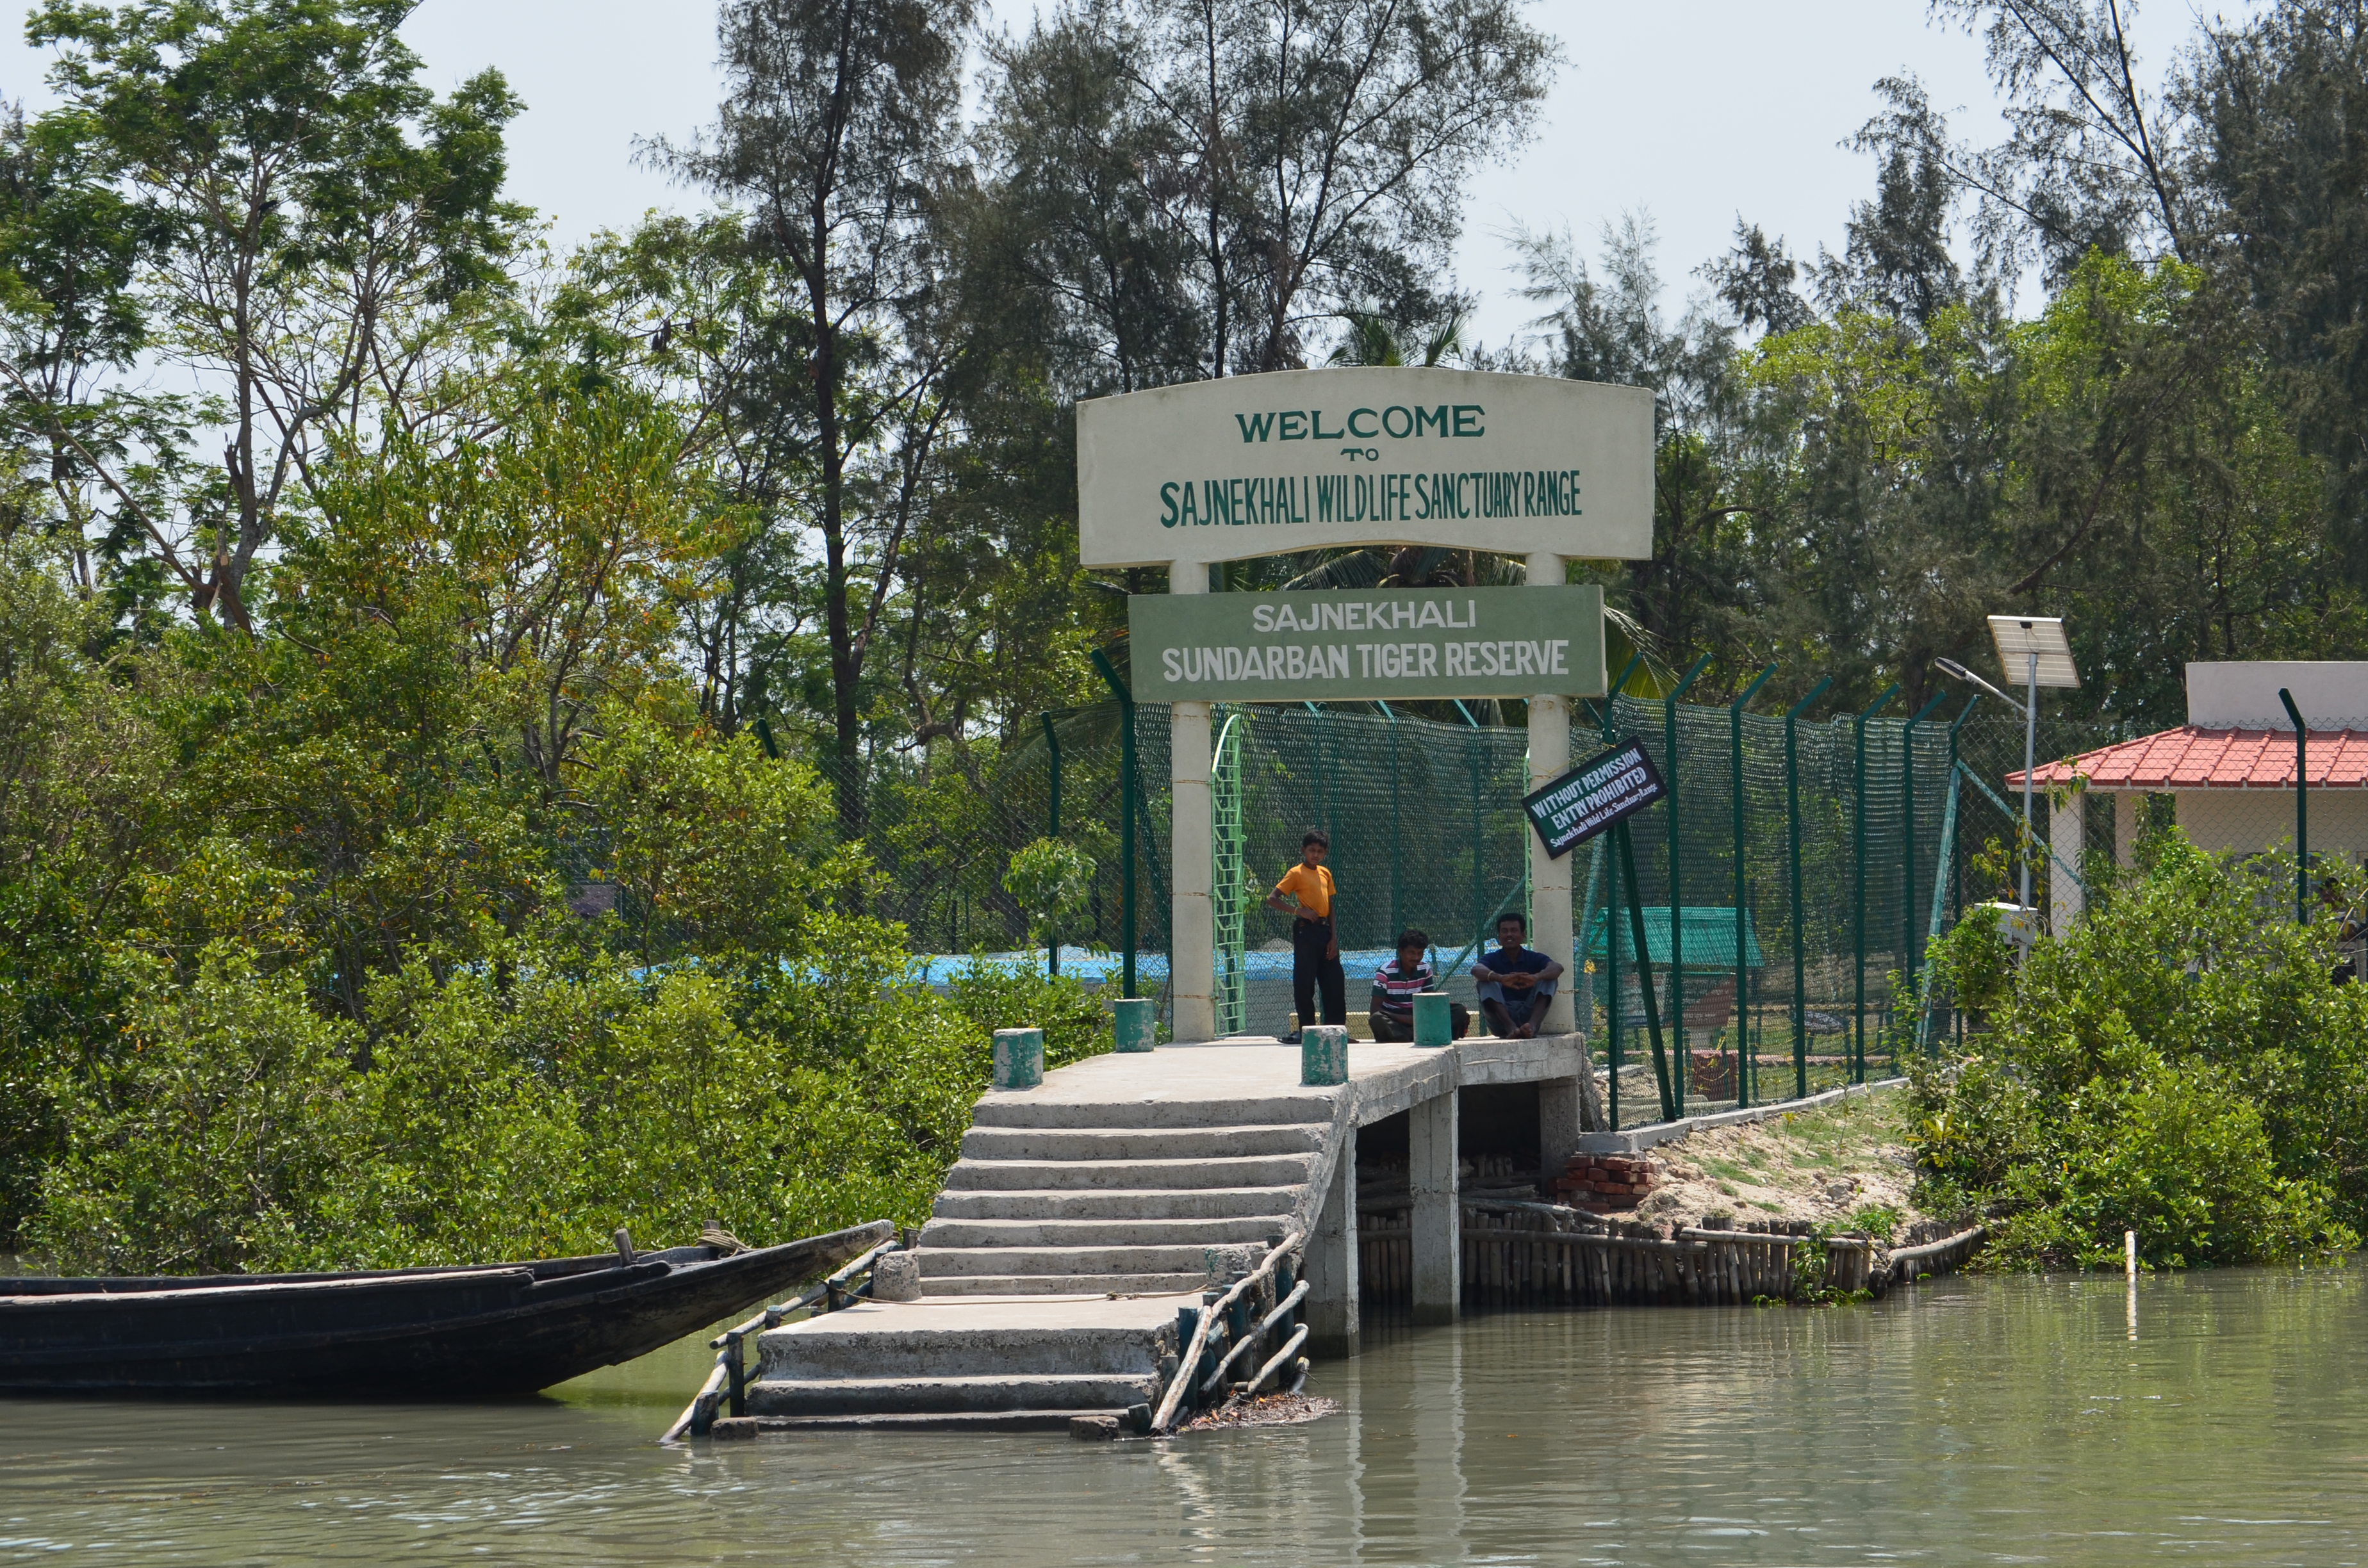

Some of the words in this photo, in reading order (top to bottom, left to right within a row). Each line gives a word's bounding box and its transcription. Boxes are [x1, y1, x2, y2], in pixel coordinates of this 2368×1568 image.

[1234, 404, 1486, 443] WELCOME
[1340, 447, 1379, 462] TO
[1160, 475, 1310, 528] SAJNEKHALI
[1315, 473, 1411, 523] WILDLIFE
[1414, 471, 1522, 520] SANCTUARY
[1524, 470, 1583, 518] RANGE
[1253, 600, 1476, 632] SAJNEKHALI
[1162, 644, 1349, 682] SUNDARBAN
[1356, 642, 1438, 678] TIGER
[1445, 639, 1569, 676] RESERVE
[1531, 780, 1584, 819] WITHOUT
[1581, 747, 1642, 793] PERMISSION
[1550, 799, 1590, 830] ENTRY
[1586, 766, 1647, 811] PROHIBITED
[1550, 822, 1588, 847] Sajnekhali
[1584, 813, 1602, 828] Wild
[1598, 806, 1615, 820] Life
[1611, 794, 1642, 813] Sanctuary
[1638, 783, 1658, 797] Range
